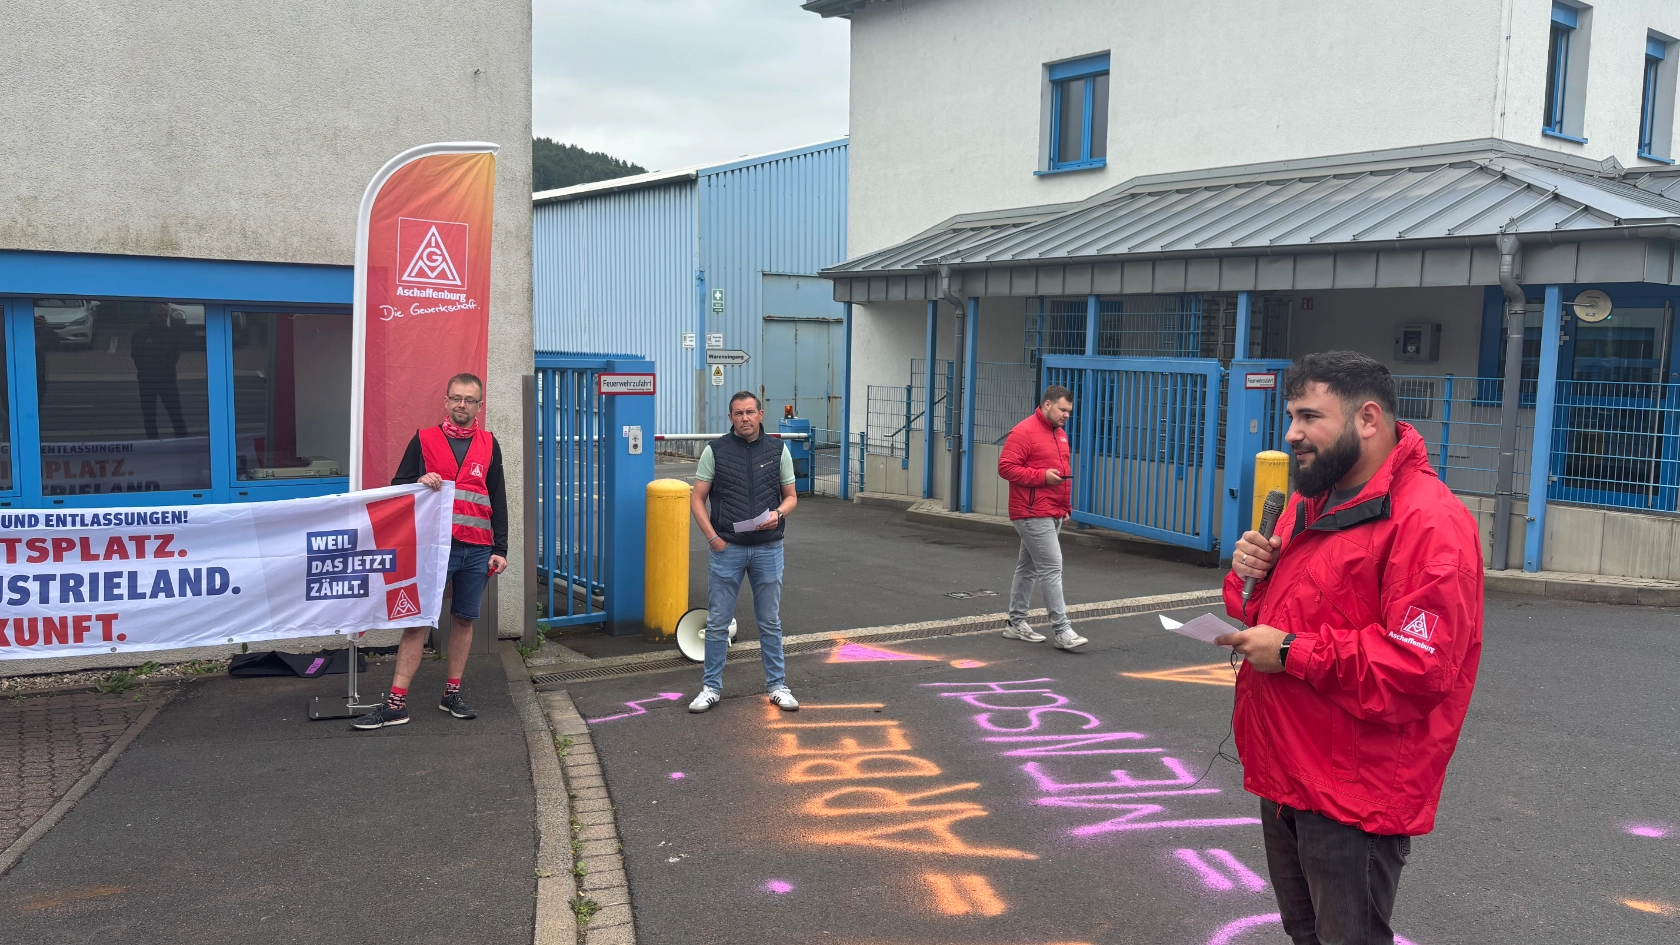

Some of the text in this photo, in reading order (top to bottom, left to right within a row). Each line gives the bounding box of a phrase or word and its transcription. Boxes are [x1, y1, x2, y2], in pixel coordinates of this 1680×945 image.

[396, 286, 467, 303] Aschaffenburg
[379, 304, 404, 322] Die
[708, 353, 745, 362] Wareneingang
[602, 379, 652, 388] Feuerwehrzufahrt
[1, 510, 189, 529] UND ENTLASSUNGEN!
[0, 533, 188, 564] TSPLATZ.
[311, 535, 352, 551] WEIL
[311, 554, 393, 574] DAS JETZT
[0, 566, 242, 606] STRIELAND.
[310, 578, 365, 597] ZÄHLT.
[1388, 630, 1436, 655] Aschaffenburg
[917, 677, 1262, 838] MENSCH
[763, 697, 1040, 861] ARBEIT
